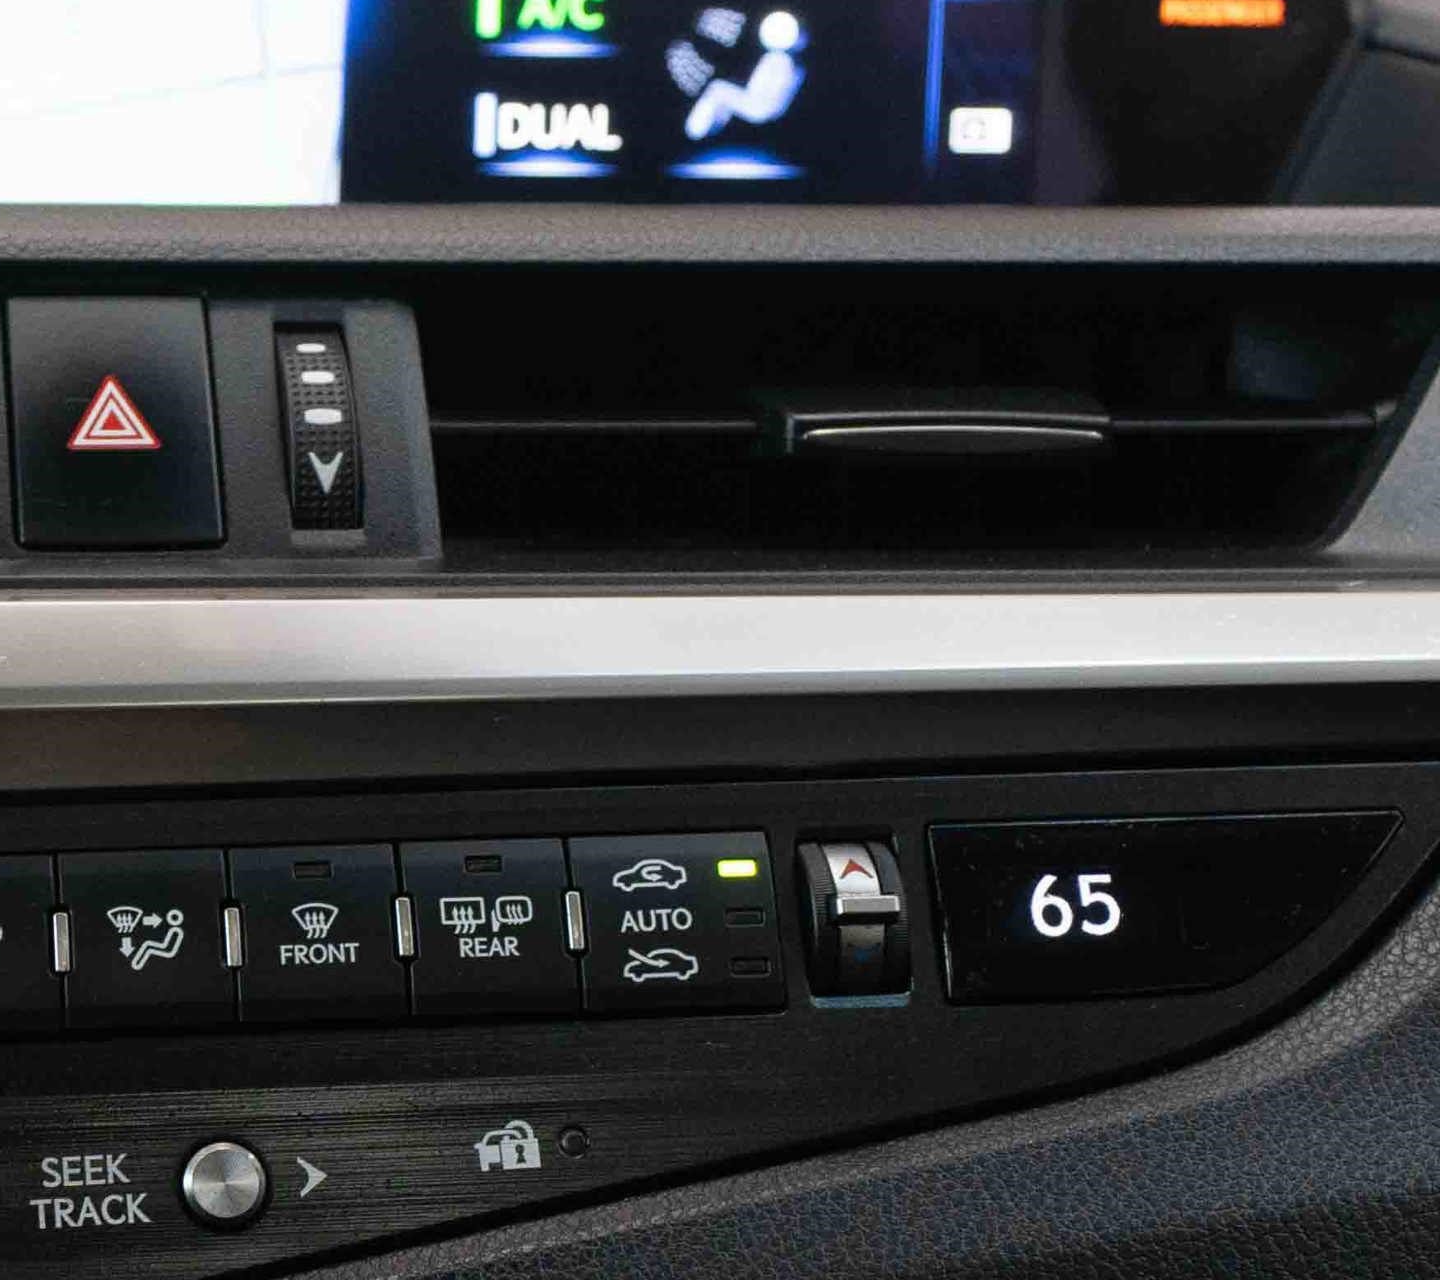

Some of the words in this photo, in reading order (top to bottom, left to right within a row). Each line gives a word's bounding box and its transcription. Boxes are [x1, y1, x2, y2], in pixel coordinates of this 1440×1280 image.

[497, 102, 623, 152] DUAL
[620, 907, 693, 933] AUTO
[1029, 873, 1121, 938] 65
[279, 942, 360, 966] FRONT
[458, 935, 521, 959] REAR
[41, 1152, 131, 1188] SEEK
[29, 1192, 152, 1230] TRACK
